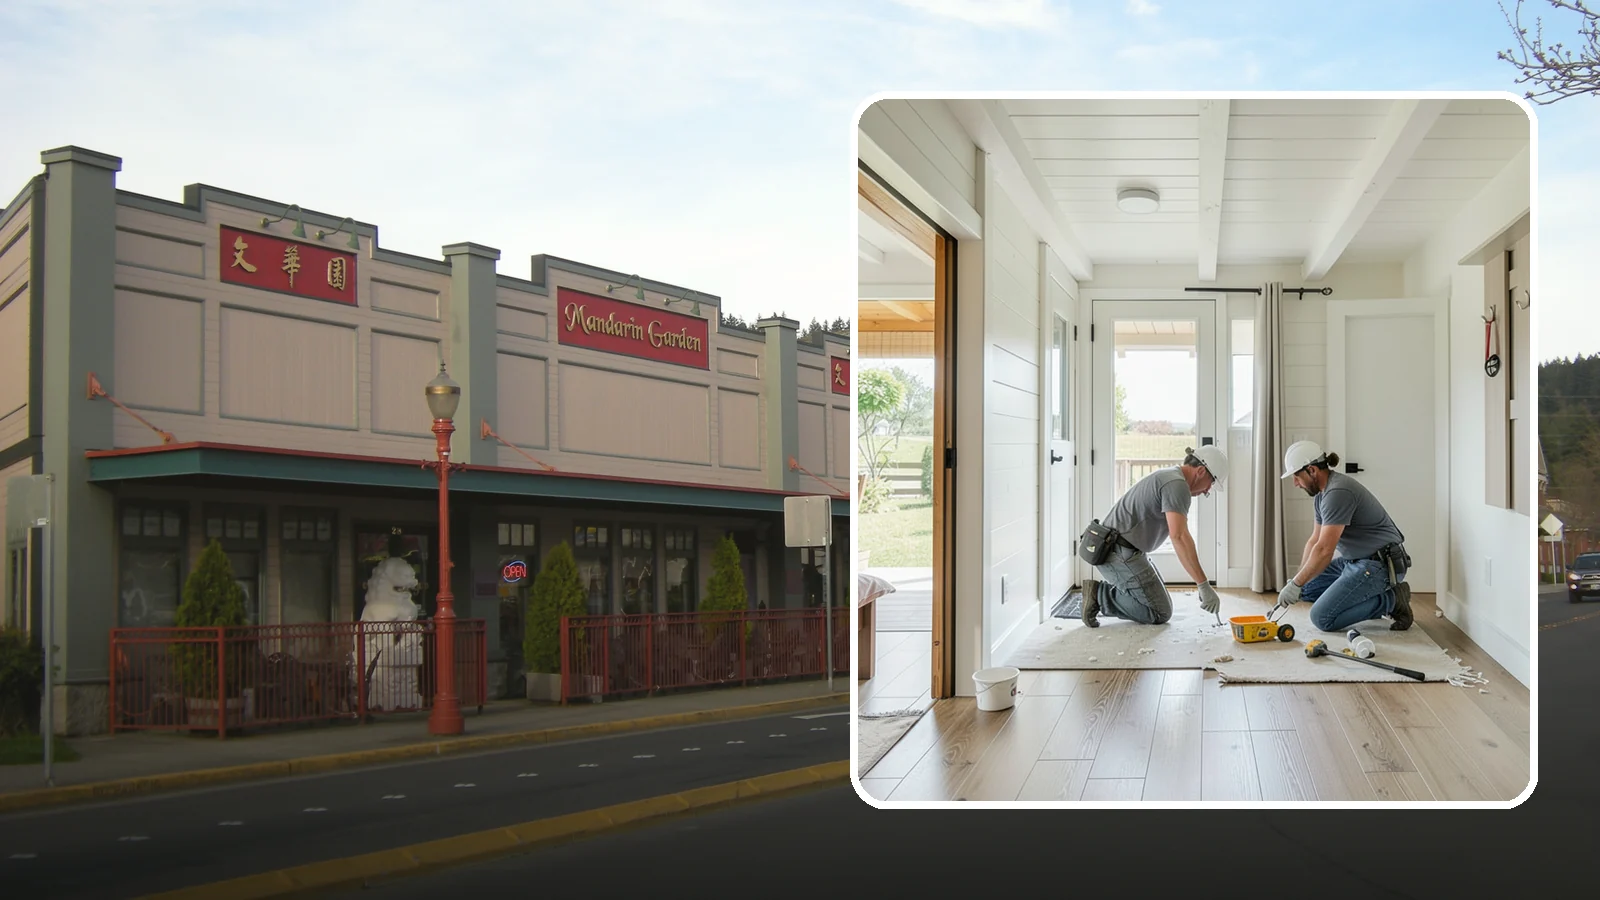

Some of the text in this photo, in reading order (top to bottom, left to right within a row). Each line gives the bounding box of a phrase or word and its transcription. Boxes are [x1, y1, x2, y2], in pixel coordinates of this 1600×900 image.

[565, 302, 701, 352] Mandarin Garden
[503, 565, 527, 578] OPEN
